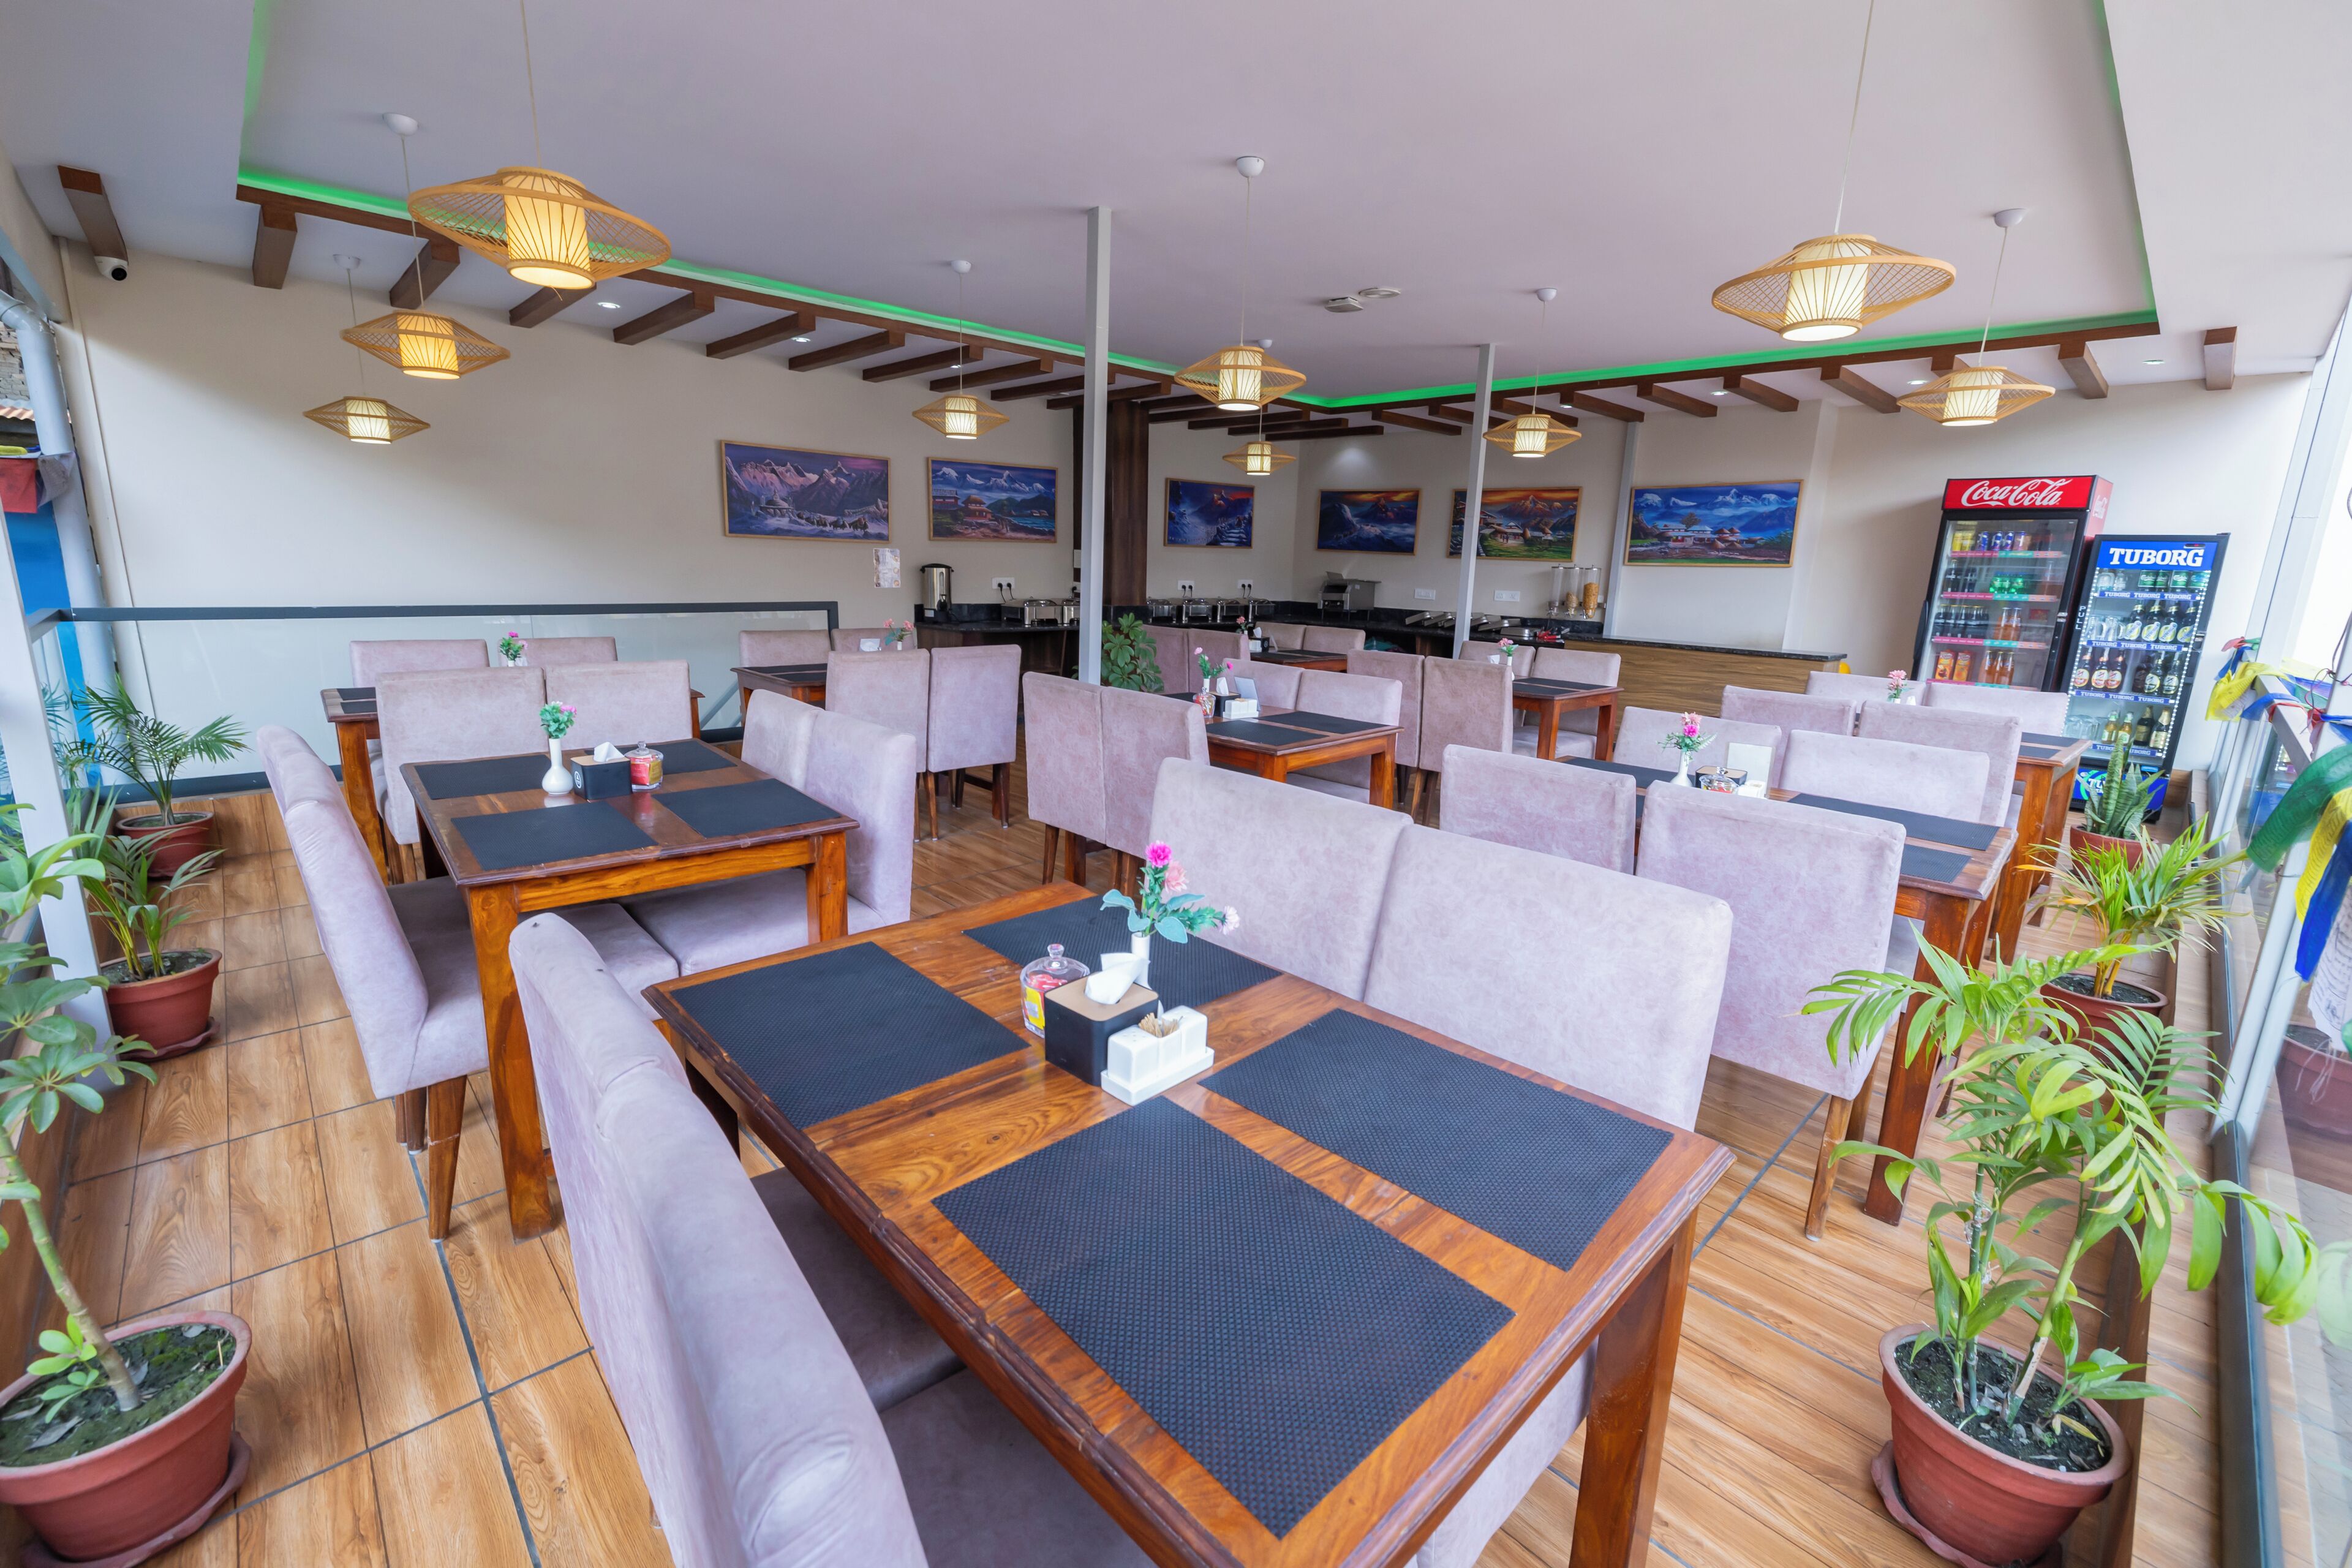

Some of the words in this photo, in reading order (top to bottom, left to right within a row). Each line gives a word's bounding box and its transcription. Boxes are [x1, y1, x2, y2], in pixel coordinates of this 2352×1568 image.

[1961, 478, 2073, 507] Coca-Cola
[2109, 548, 2204, 567] TUBORG
[2075, 606, 2086, 630] PULL
